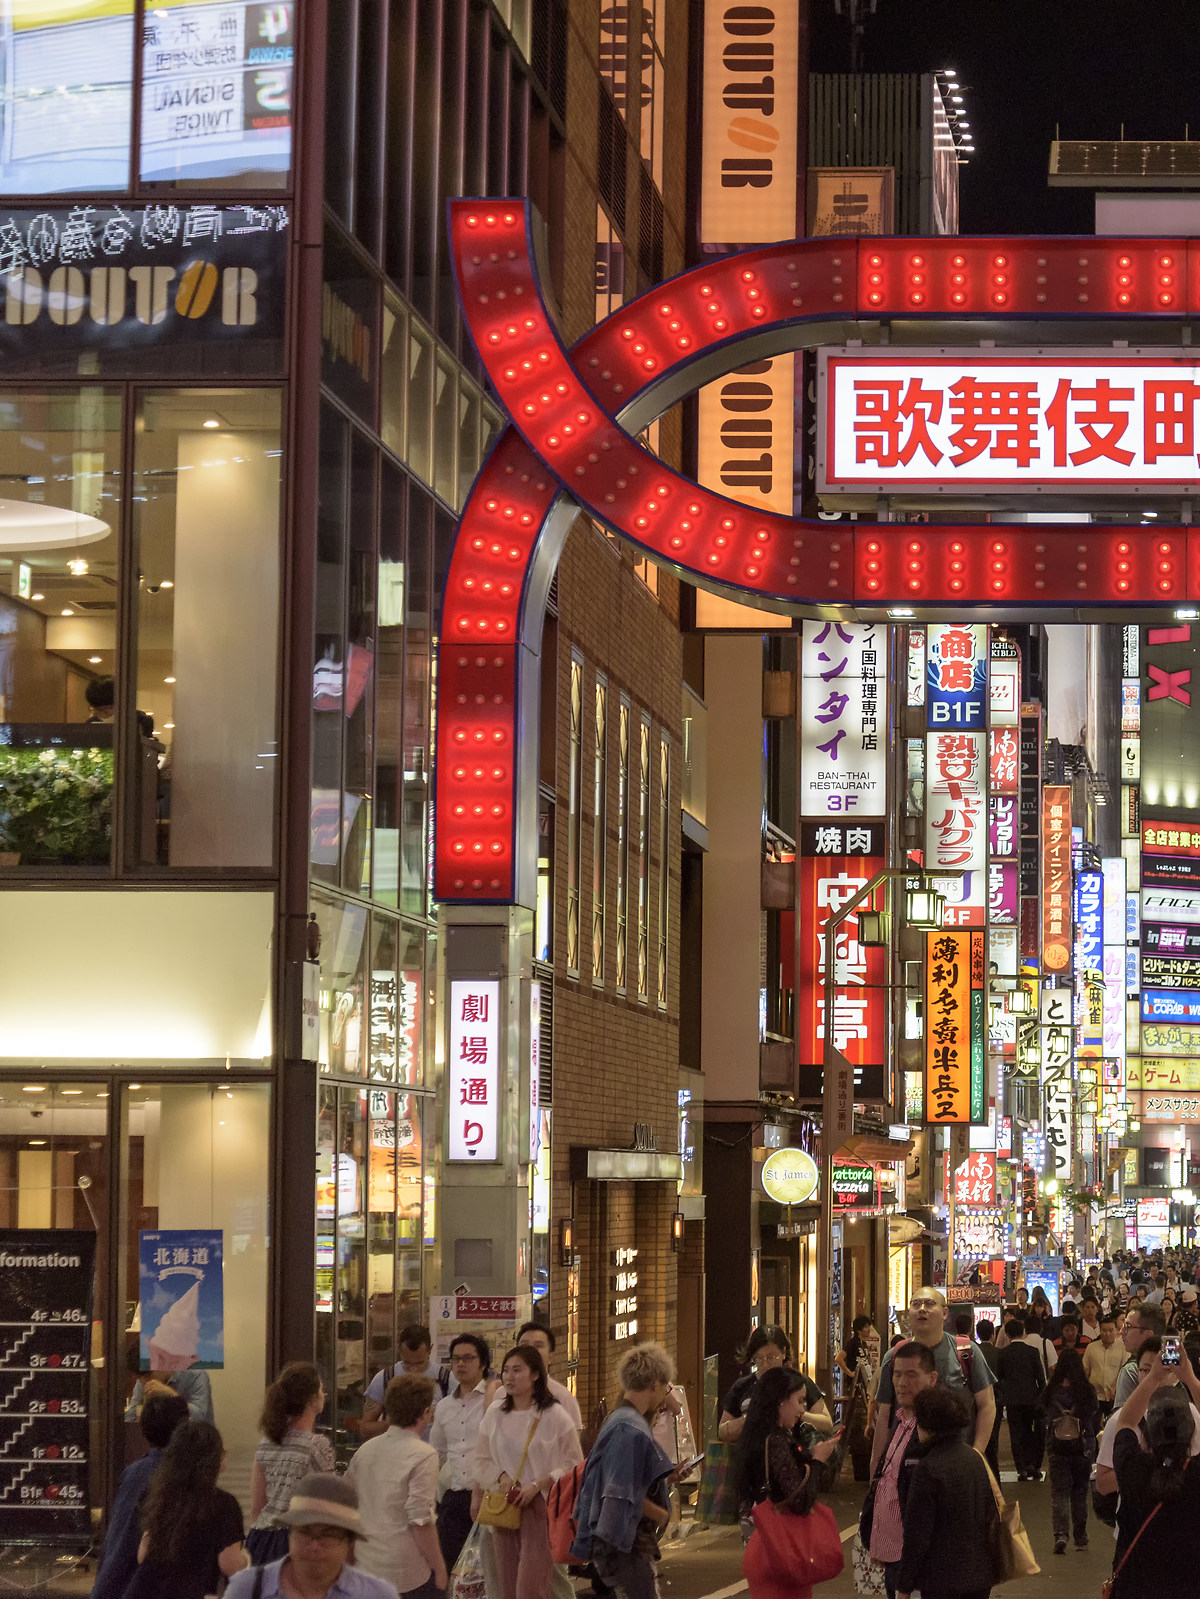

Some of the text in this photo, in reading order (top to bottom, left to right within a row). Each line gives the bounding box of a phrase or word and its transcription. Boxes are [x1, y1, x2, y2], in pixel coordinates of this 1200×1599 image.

[939, 625, 977, 692] 商店
[932, 701, 981, 723] B1F
[817, 771, 870, 780] BAN-THAI
[809, 781, 878, 790] RESTAURANT
[827, 795, 859, 812] 3F
[931, 734, 984, 867] 熟女キャバクラ
[996, 797, 1014, 856] レンタル
[815, 827, 872, 855] 焼肉
[1049, 804, 1064, 935] 個室ダイニング居酒屋
[944, 908, 972, 926] 4F
[1079, 873, 1102, 955] カラオケ
[816, 872, 869, 1051] 安楽亭
[972, 936, 983, 983] 炭火串焼
[1089, 986, 1102, 1025] 麻雀
[459, 994, 489, 1148] 劇場通り
[1144, 1068, 1182, 1084] ゲーム
[1146, 1097, 1200, 1111] メンズサウナ
[838, 1192, 858, 1204] Bar
[152, 1247, 210, 1266] 北海道
[948, 1288, 974, 1300] 19:00
[31, 1309, 48, 1322] 4F
[29, 1355, 47, 1368] 3F
[29, 1401, 47, 1414] 2F
[31, 1447, 46, 1459] 1F
[20, 1485, 43, 1499] B1F
